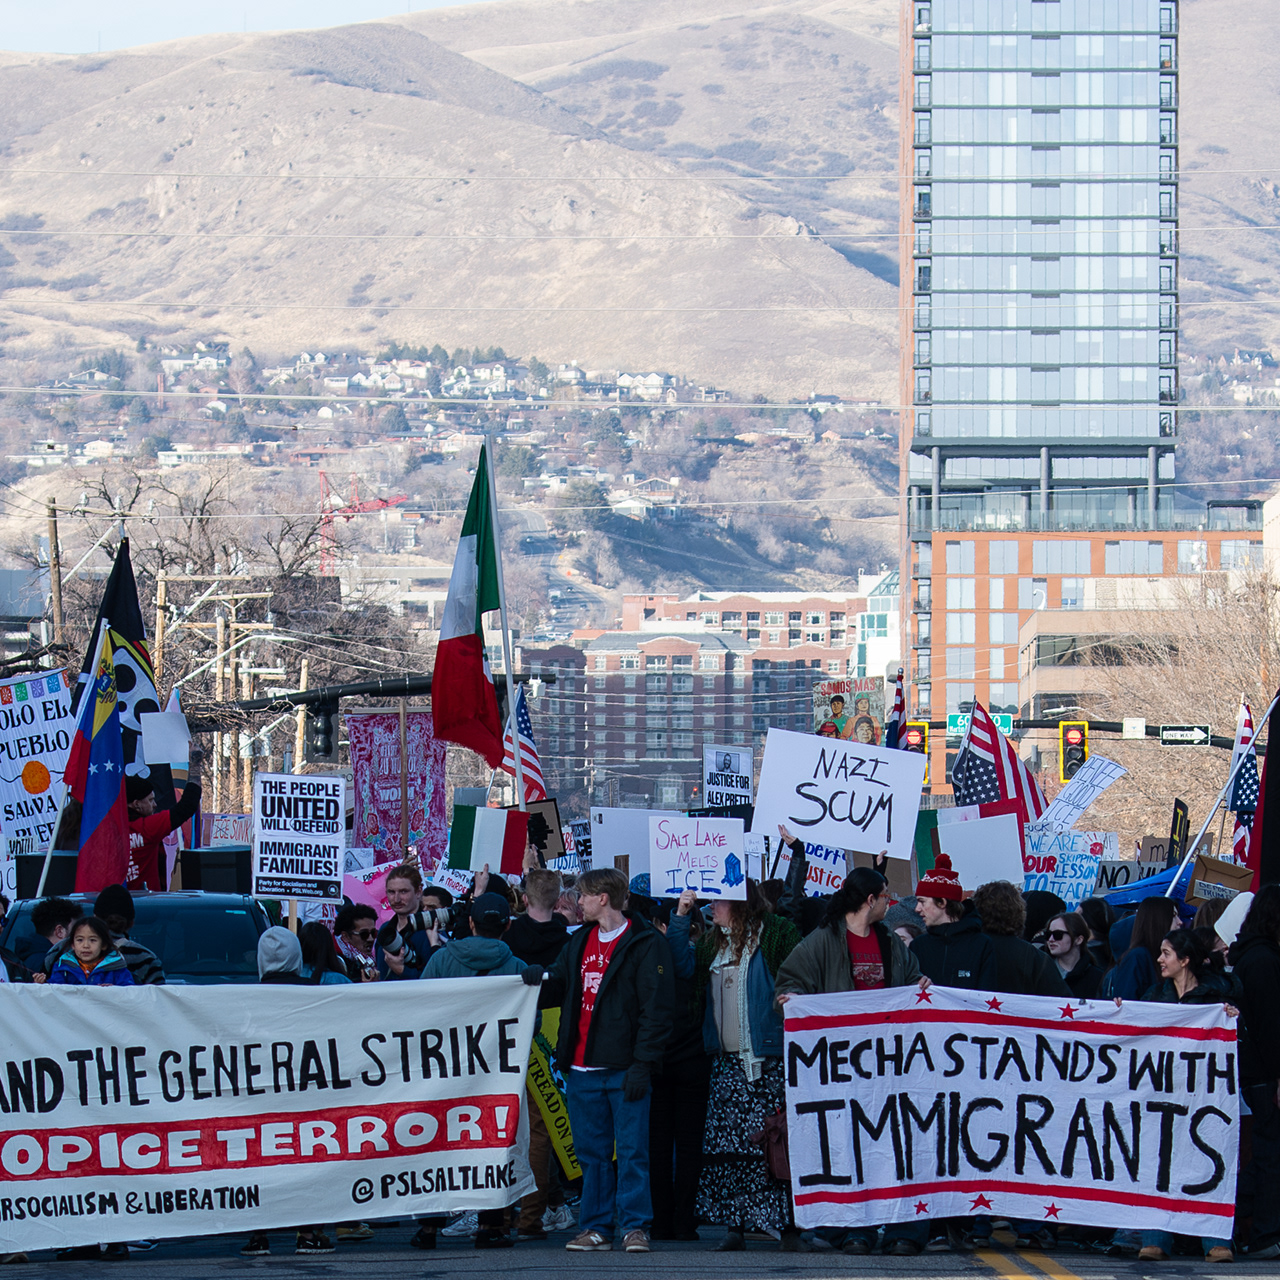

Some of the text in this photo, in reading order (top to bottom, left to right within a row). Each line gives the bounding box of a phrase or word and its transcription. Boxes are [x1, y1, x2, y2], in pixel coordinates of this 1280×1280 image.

[821, 681, 851, 696] SOMOS
[42, 699, 68, 721] EL
[813, 748, 890, 787] NAZI
[261, 781, 340, 797] THE PEOPLE
[706, 772, 750, 790] JUSTICE FOR
[4, 795, 57, 822] SALVA
[261, 796, 339, 820] UNITED
[707, 791, 724, 806] ALEX
[789, 782, 893, 843] SCUM
[261, 818, 339, 834] WILL DEFEND
[656, 820, 727, 850] SALT LAKE
[260, 841, 339, 859] IMMIGRANT
[1027, 835, 1082, 852] WE ARE
[259, 857, 338, 877] FAMILIES!
[677, 851, 719, 869] MELTS
[1024, 855, 1098, 880] OUR LESSON
[258, 880, 272, 888] Party
[665, 869, 722, 894] ICE
[1099, 865, 1130, 888] NO
[258, 886, 284, 894] Liberation
[67, 1046, 150, 1106] THE
[158, 1038, 352, 1104] GENERAL
[360, 1017, 521, 1087] STRIKE
[787, 1031, 1237, 1095] MECHA STANDS WITH
[529, 1056, 580, 1169] TREAD ON ME
[98, 1129, 202, 1169] ICE
[216, 1105, 509, 1162] TERROR!
[795, 1091, 1233, 1196] IMMIGRANTS
